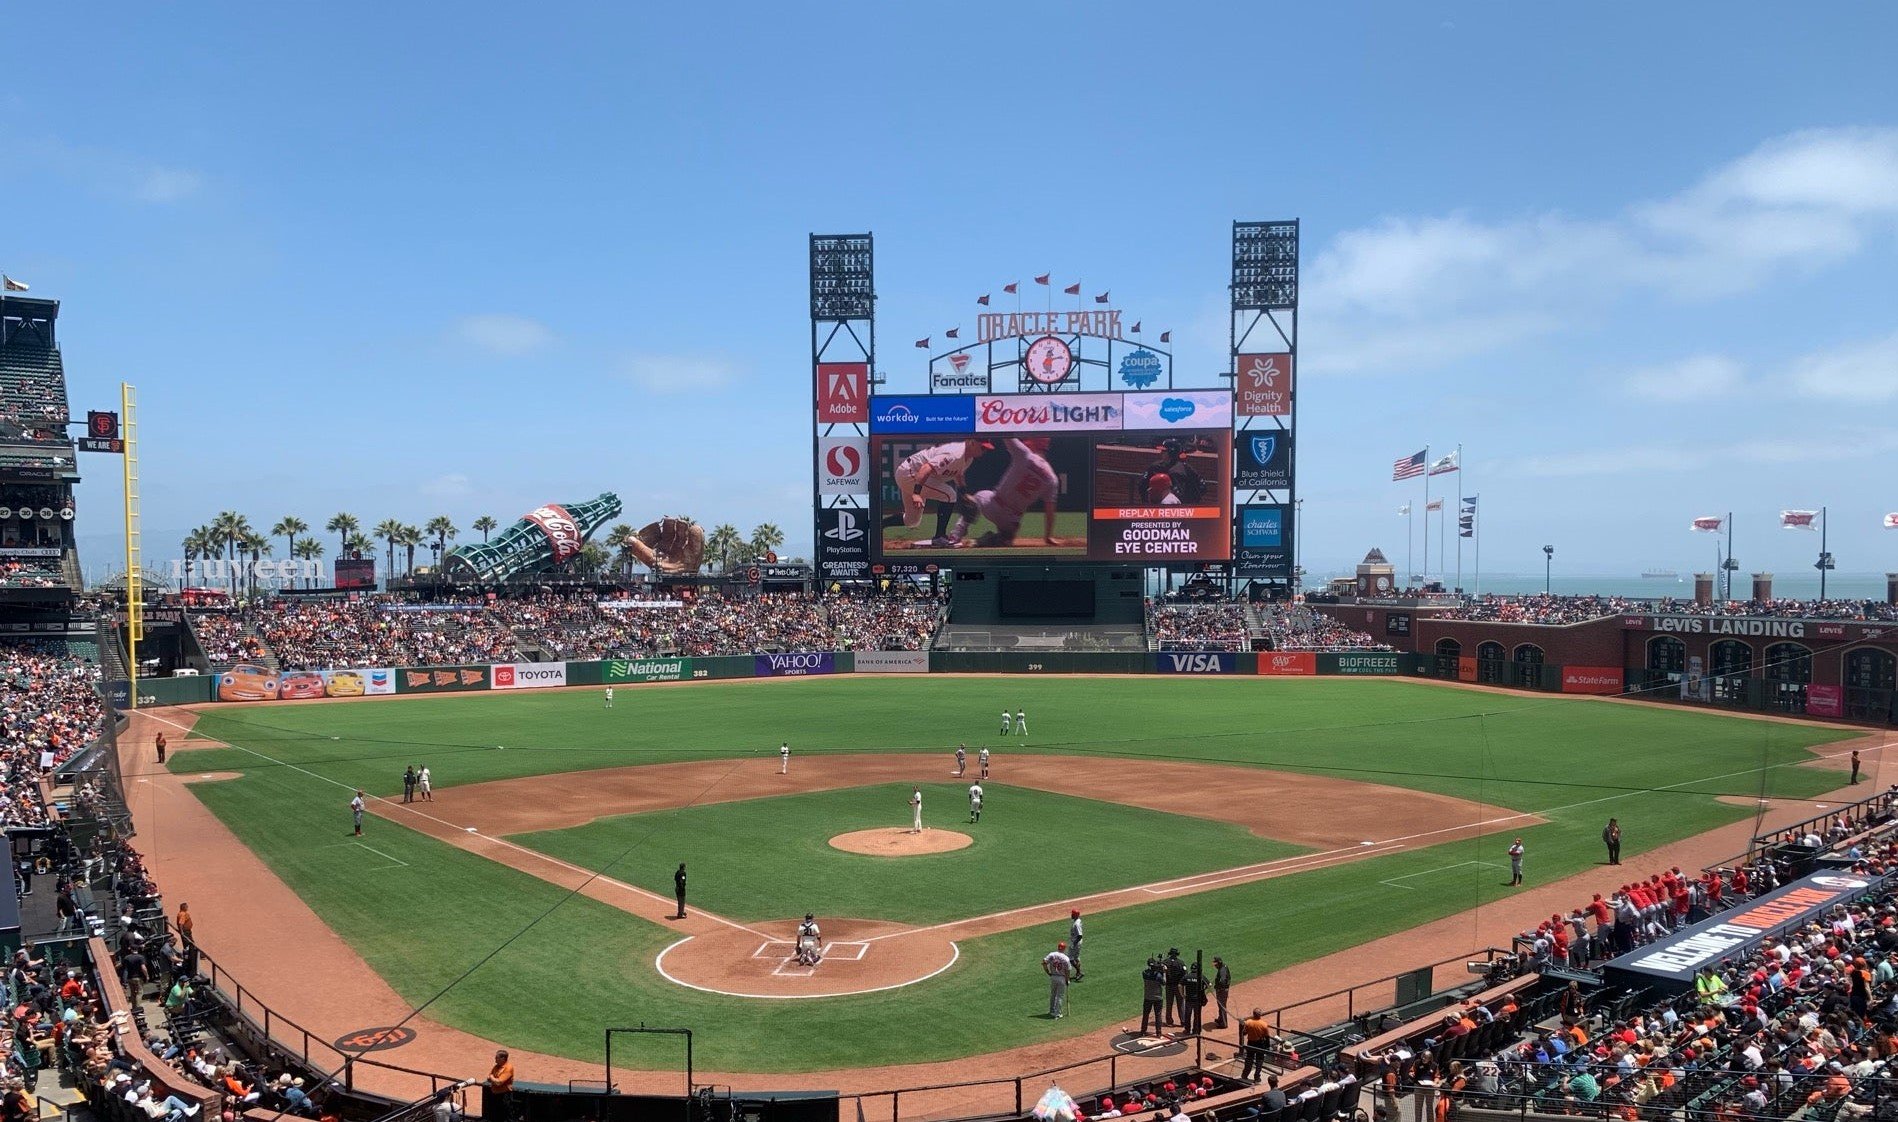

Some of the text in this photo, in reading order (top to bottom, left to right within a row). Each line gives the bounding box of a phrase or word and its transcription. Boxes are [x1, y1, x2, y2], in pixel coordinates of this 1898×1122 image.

[978, 310, 1122, 344] ORACLE PARK
[1124, 357, 1158, 368] coupa
[934, 373, 987, 387] Fanatics
[1244, 390, 1283, 403] Dignity
[829, 404, 857, 413] Adobe
[982, 400, 1112, 424] Coors LIGHT
[1246, 403, 1281, 413] Health
[877, 413, 919, 423] workday
[86, 440, 97, 448] WE
[98, 441, 110, 449] ARE
[1119, 508, 1194, 518] REPLAY REVIEW
[1247, 520, 1277, 528] charles
[1123, 529, 1190, 540] GOODMAN
[1115, 542, 1198, 553] EYE CENTER
[892, 565, 918, 573] $7,320
[155, 611, 182, 623] PARK
[1709, 619, 1804, 638] LANDING
[769, 654, 822, 670] YAHOO!
[1168, 655, 1221, 672] VISA
[627, 661, 682, 675] National
[518, 670, 562, 680] TOYOTA
[137, 696, 155, 704] 339
[1630, 932, 1744, 972] WELCOME
[1483, 1066, 1497, 1077] 22
